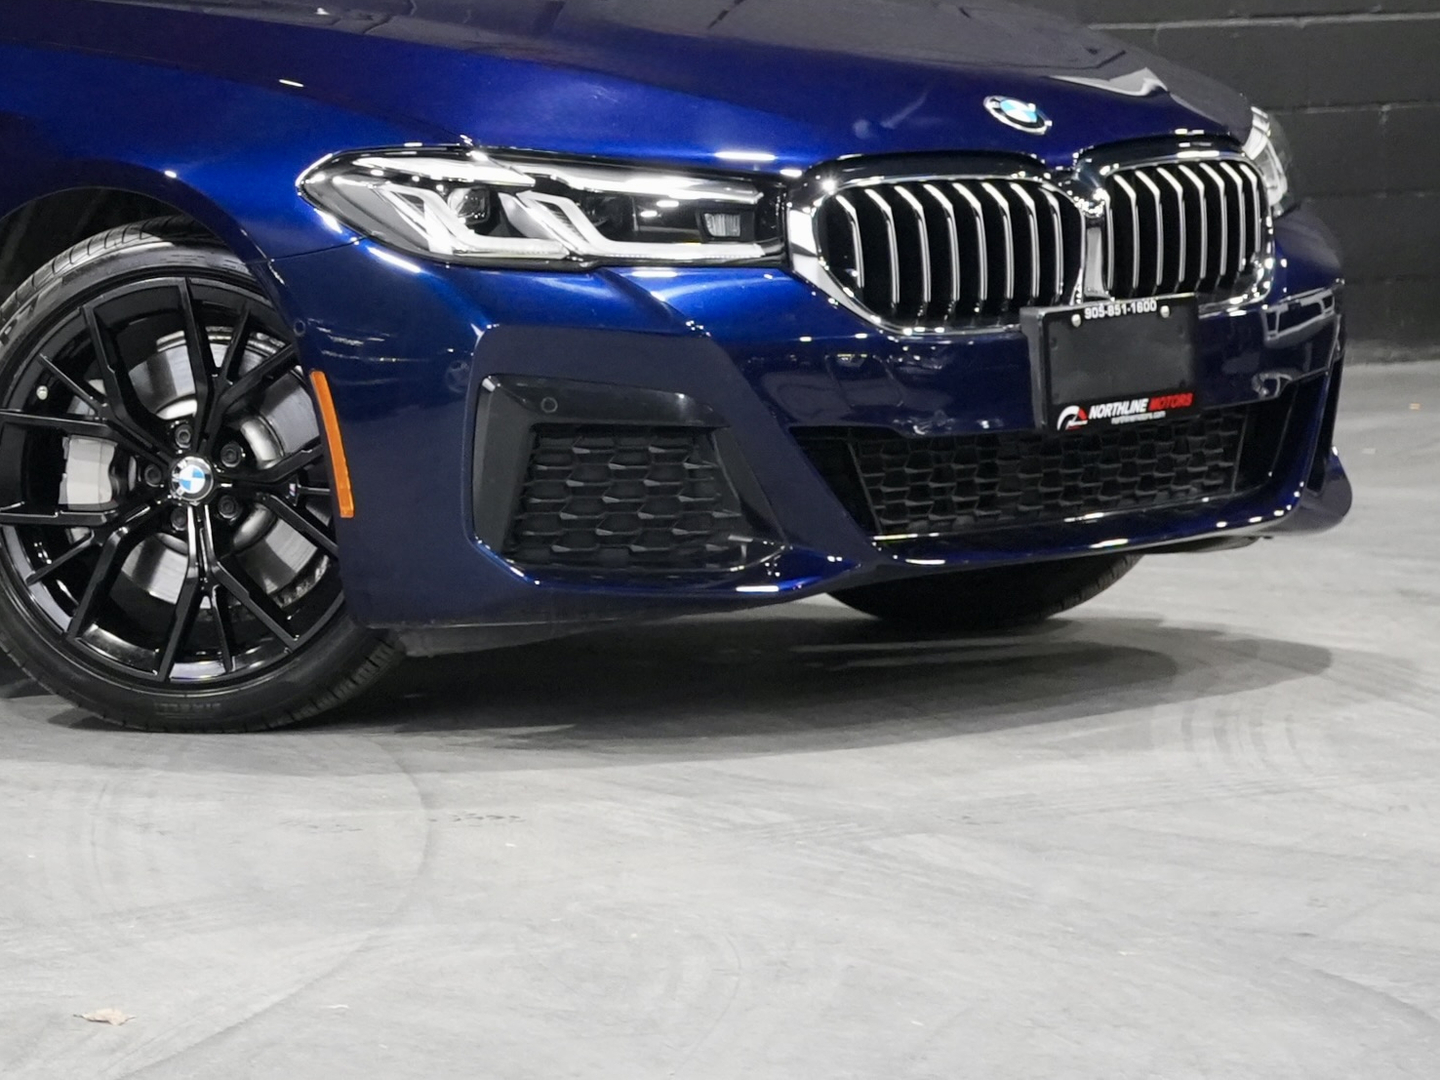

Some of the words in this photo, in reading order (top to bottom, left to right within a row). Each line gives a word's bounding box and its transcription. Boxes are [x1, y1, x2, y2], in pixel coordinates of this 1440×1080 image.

[1084, 300, 1158, 320] 905-851-1600
[1088, 398, 1150, 420] NORTHLINE
[1147, 392, 1194, 411] MOTORS
